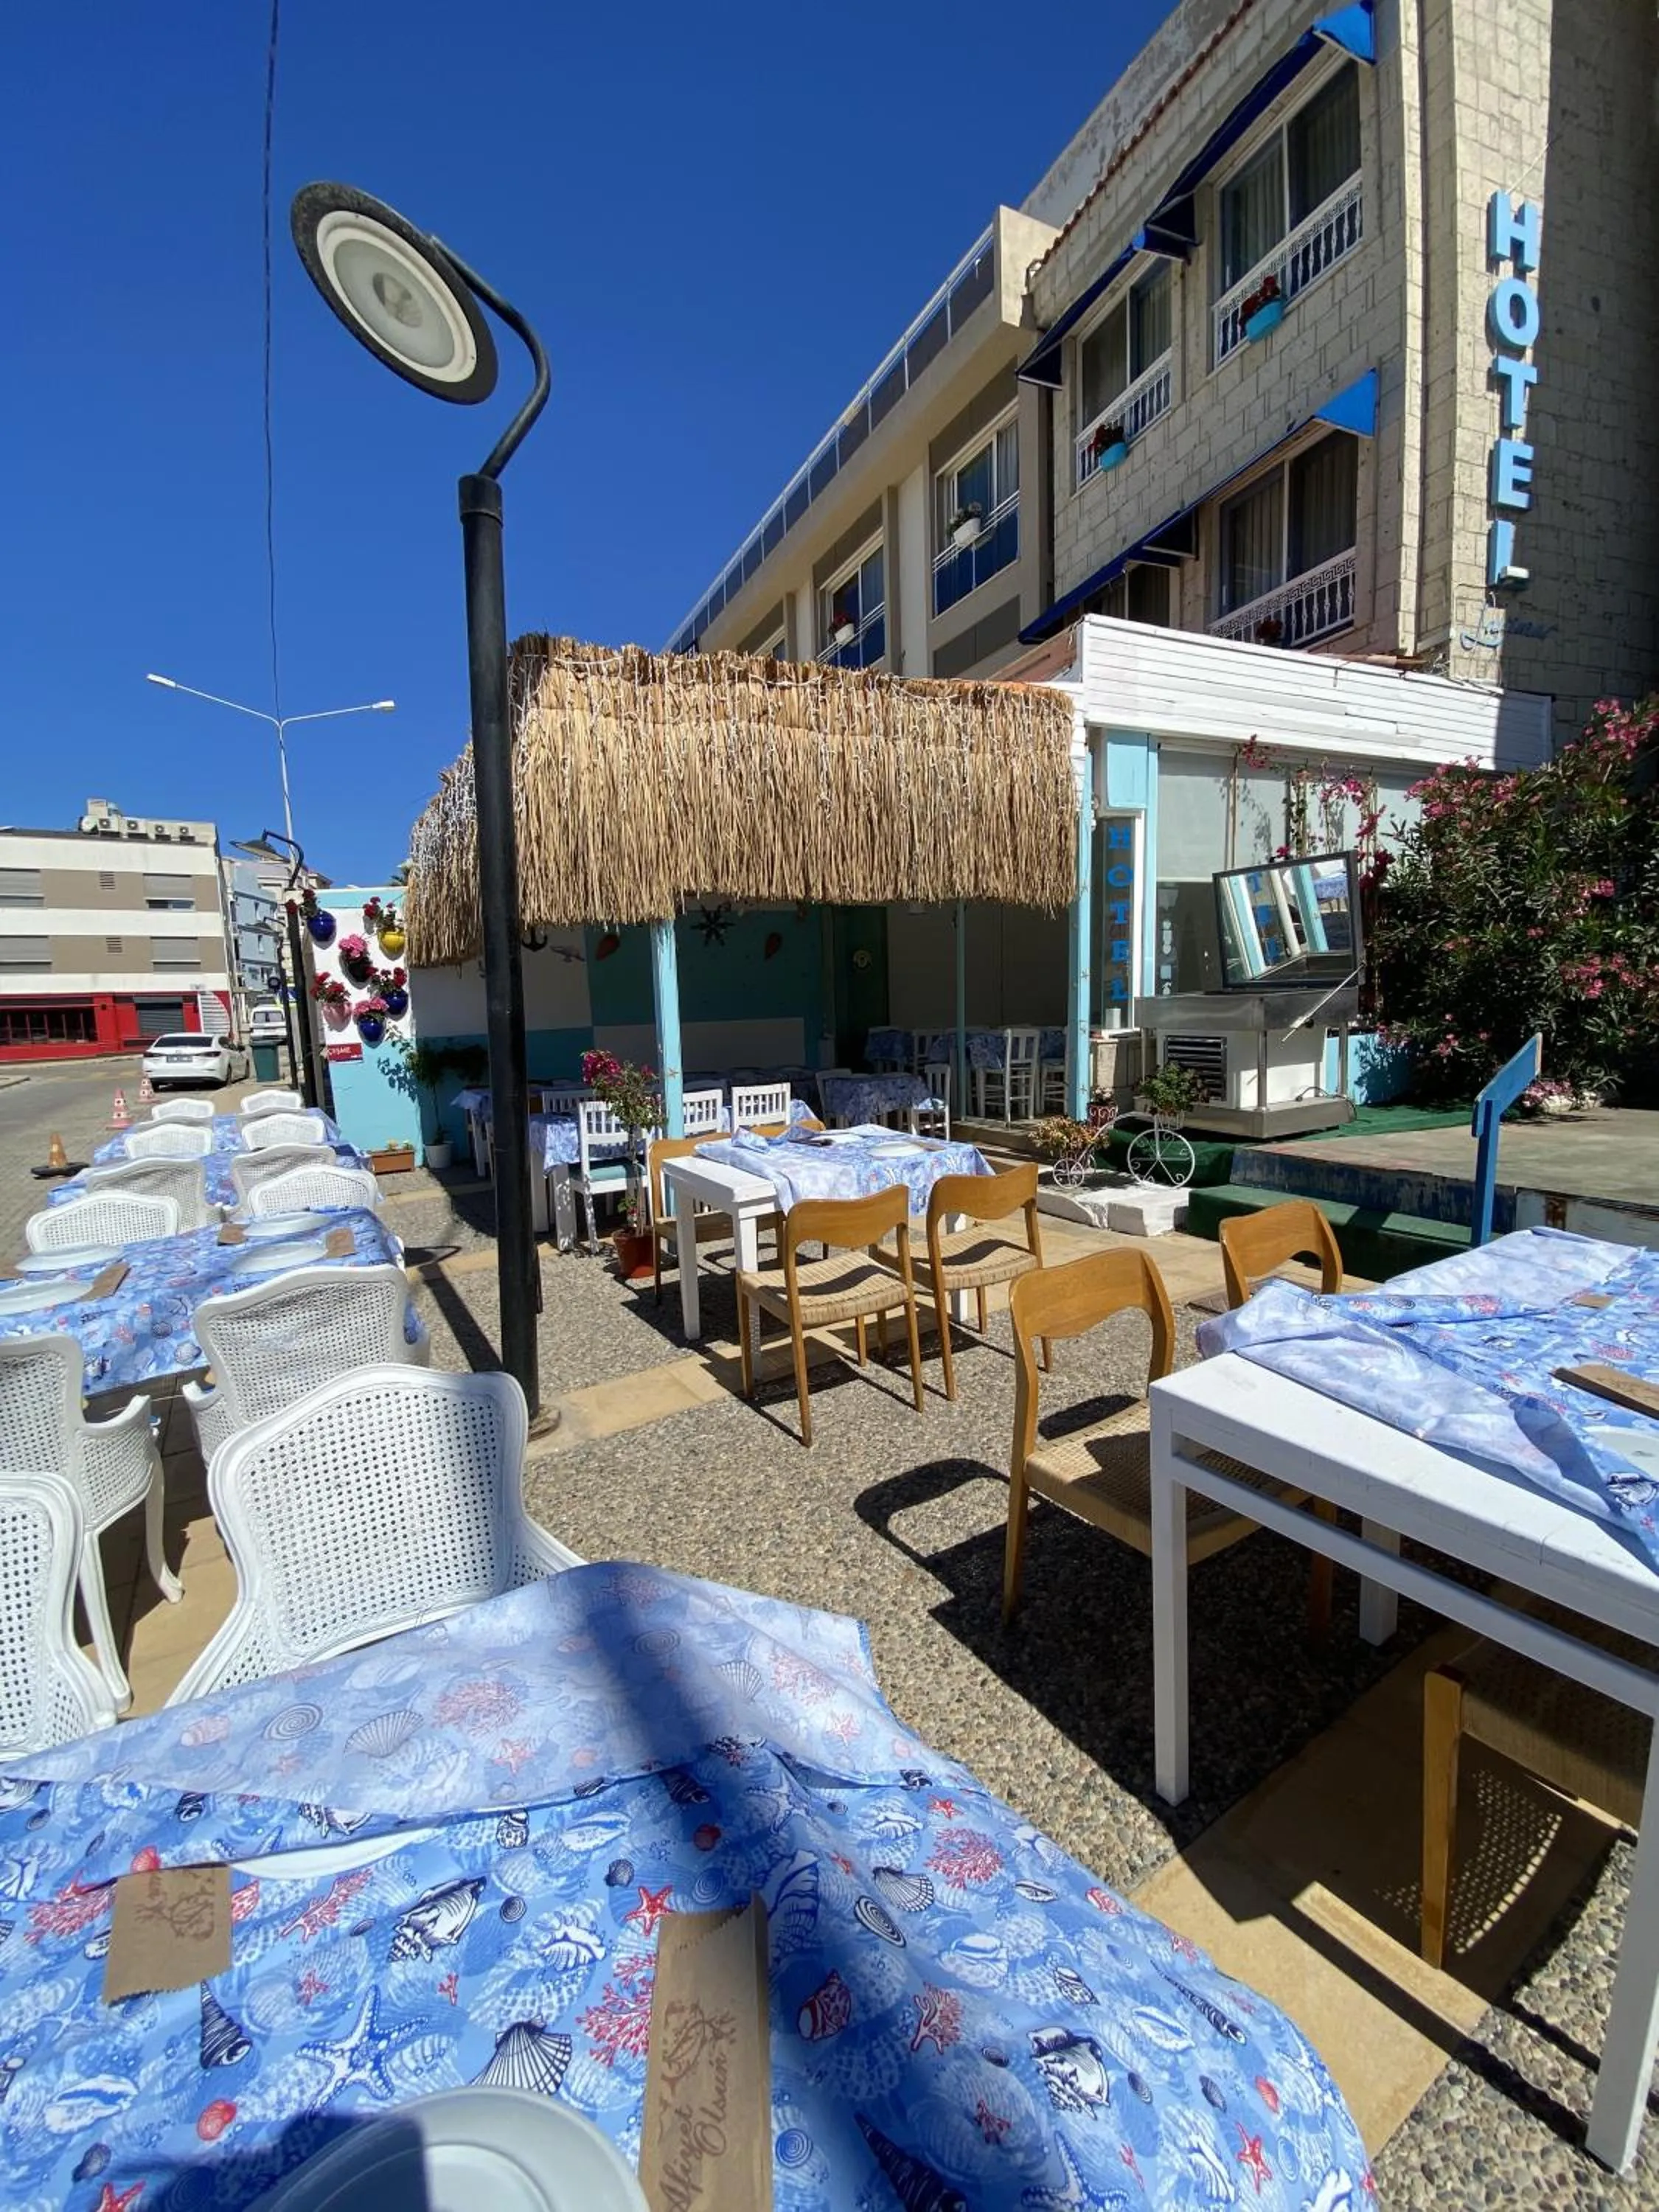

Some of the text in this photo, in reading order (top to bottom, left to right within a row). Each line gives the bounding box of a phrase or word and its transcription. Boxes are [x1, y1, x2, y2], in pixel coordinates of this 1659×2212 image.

[1488, 189, 1540, 585] HOTEL
[1107, 827, 1133, 1001] HOTEL
[692, 2052, 727, 2157] Olsun
